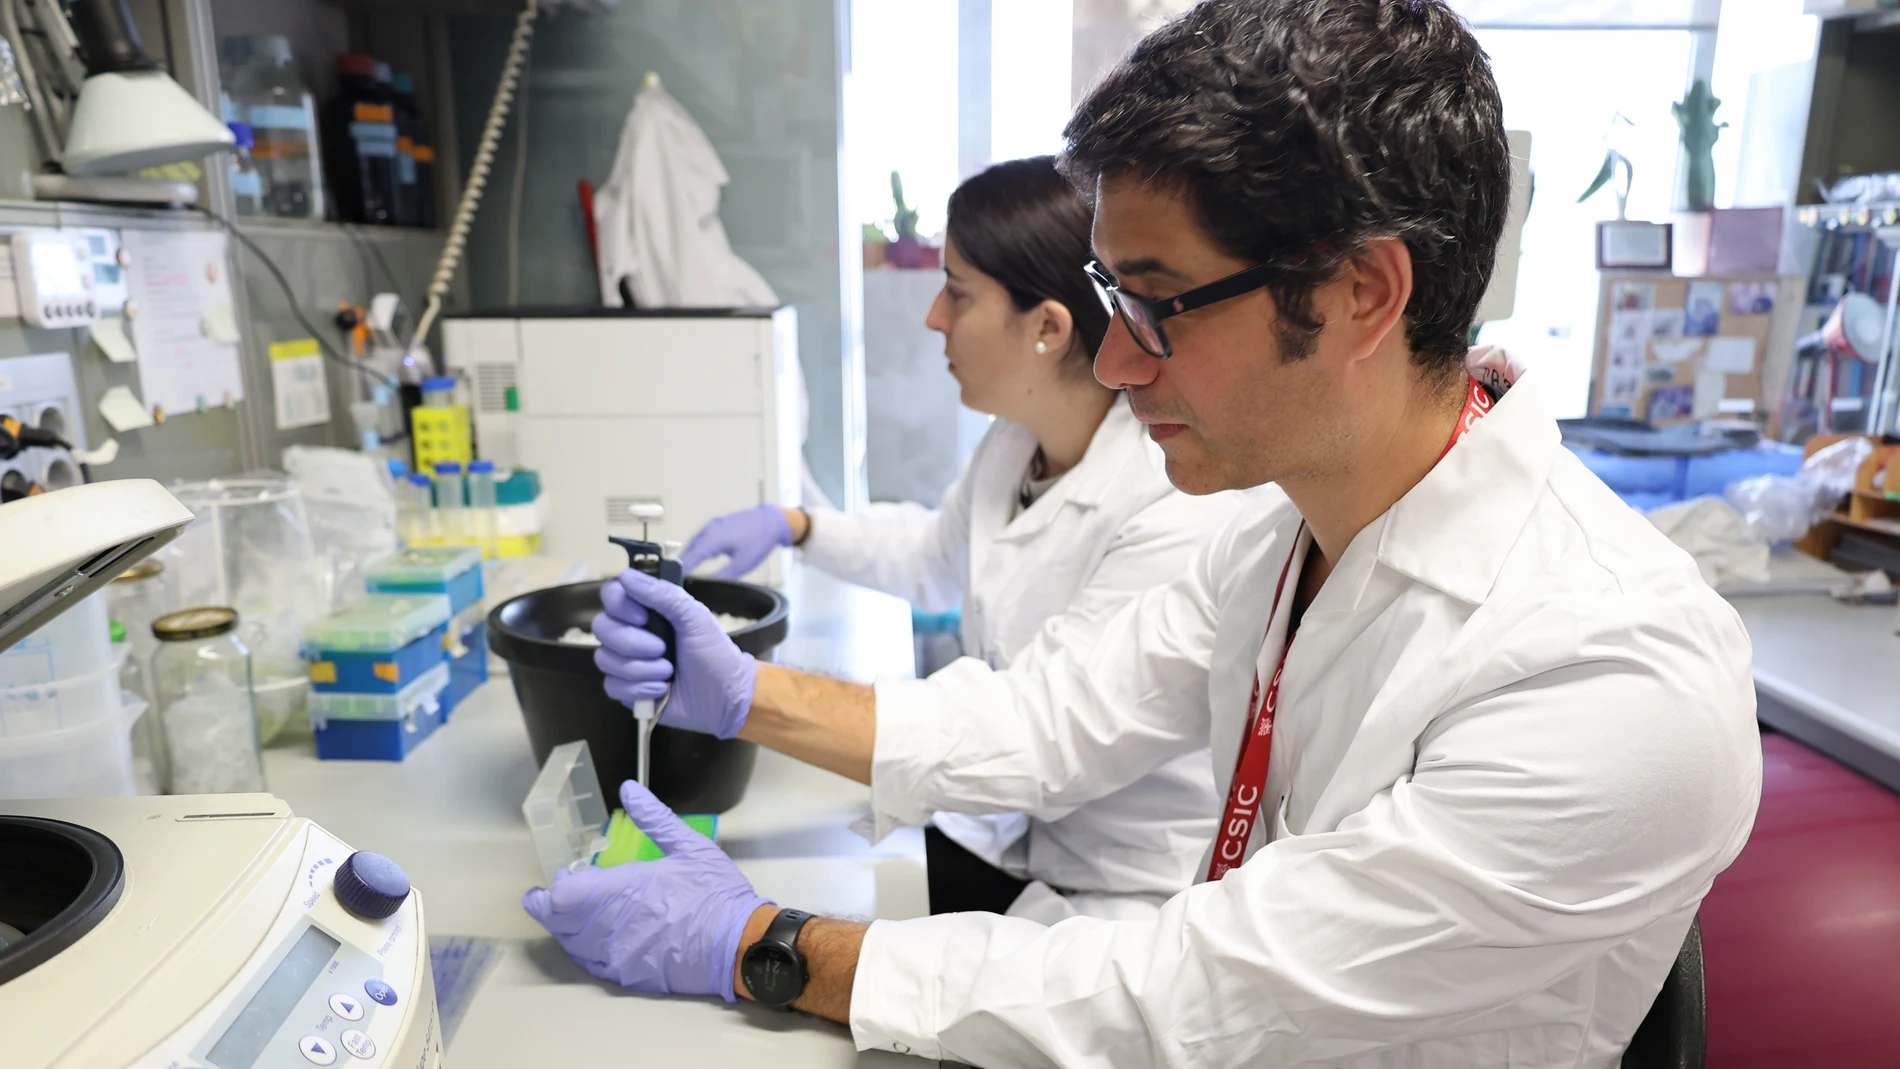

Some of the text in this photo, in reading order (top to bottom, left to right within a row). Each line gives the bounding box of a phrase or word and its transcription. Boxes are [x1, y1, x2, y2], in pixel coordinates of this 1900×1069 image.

[1222, 784, 1258, 860] CSIC
[303, 891, 320, 908] Speed
[377, 941, 392, 957] Press
[375, 985, 390, 1001] Open
[315, 1015, 334, 1031] Temp
[348, 1033, 361, 1050] Fast
[356, 1039, 373, 1056] Temp
